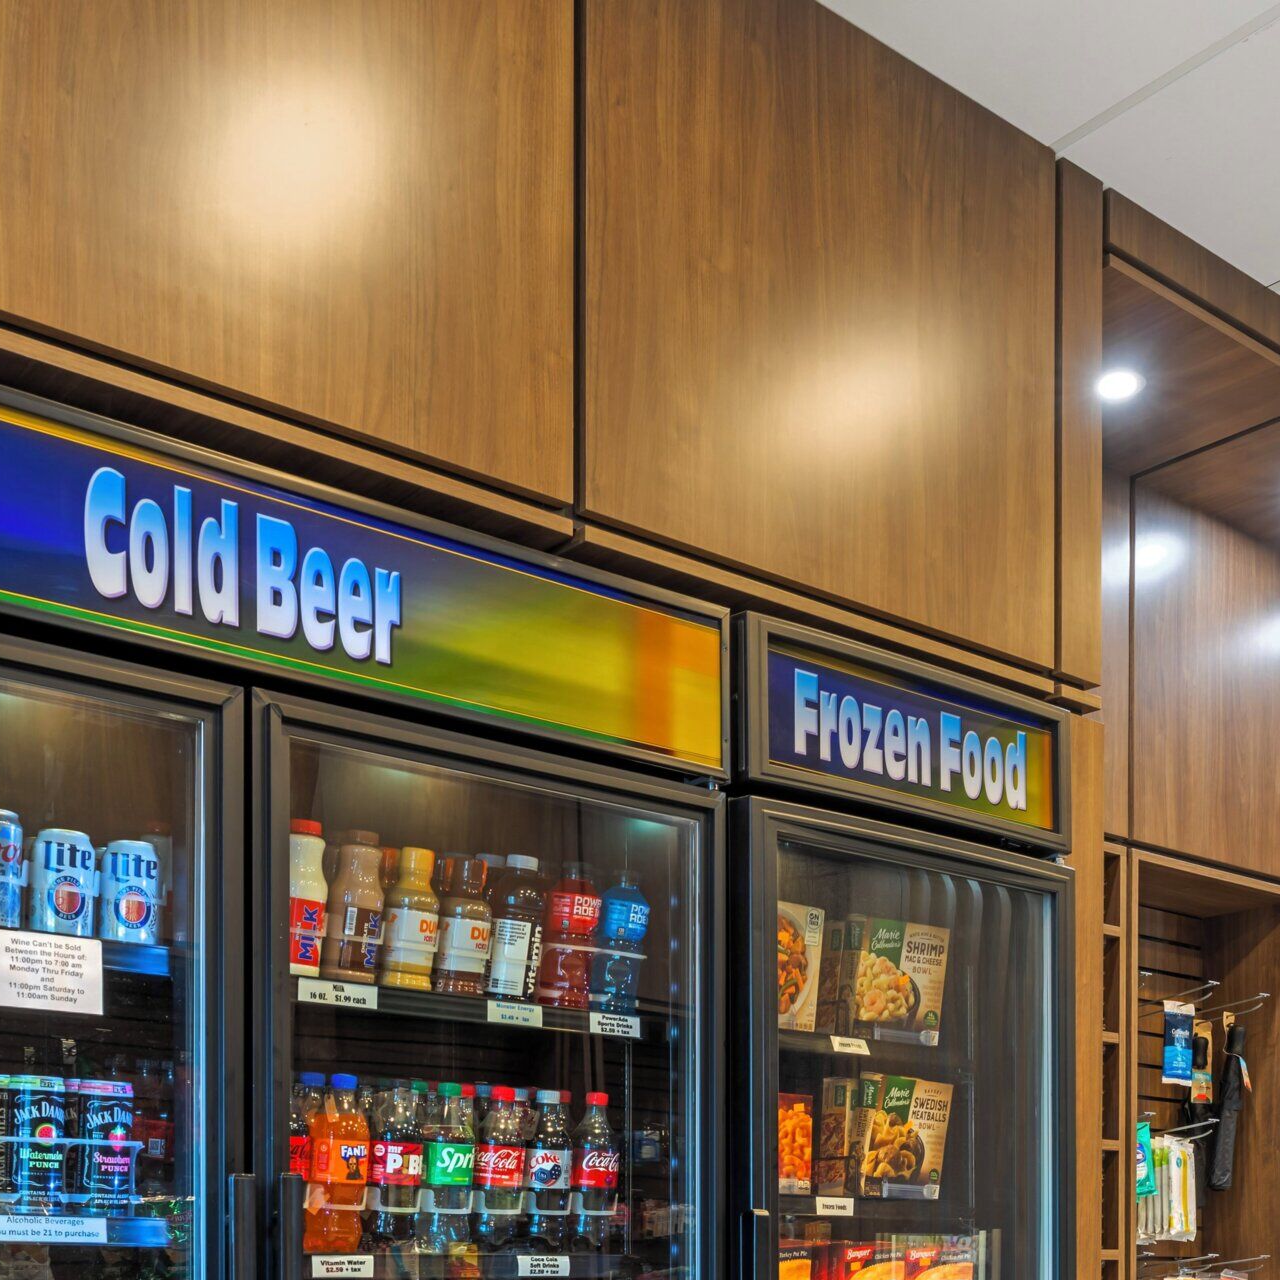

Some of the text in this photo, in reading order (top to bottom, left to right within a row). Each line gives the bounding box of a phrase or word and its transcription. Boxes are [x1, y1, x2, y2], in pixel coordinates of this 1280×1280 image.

[84, 466, 401, 664] Cold Beer
[794, 668, 1027, 811] Frozen Food
[44, 840, 91, 873] Lite
[111, 852, 158, 883] Lite
[876, 928, 901, 940] Marie
[10, 938, 30, 946] Wine
[32, 940, 52, 949] Can't
[64, 943, 81, 951] Sold
[906, 941, 945, 957] SHRIMP
[5, 946, 87, 961] Between the Hours of:
[527, 926, 543, 994] vitamin
[10, 956, 43, 965] 11:00pm
[54, 959, 69, 967] 7:00
[904, 955, 943, 967] MAC CHEESE
[9, 964, 83, 979] Monday Thru Friday
[912, 966, 933, 975] BOWL
[9, 982, 41, 991] 11:00pm
[43, 985, 75, 995] Saturday
[332, 984, 345, 993] Milk
[16, 991, 78, 1004] 11:00am Sunday
[352, 995, 367, 1005] each
[616, 1022, 633, 1030] Drinks
[886, 1087, 910, 1099] Marie
[914, 1097, 949, 1112] SWEDISH
[14, 1105, 39, 1124] JACK
[86, 1110, 111, 1129] JACK
[912, 1110, 947, 1123] MEATBALLS
[387, 1145, 403, 1153] mr
[6, 1215, 85, 1227] Alcoholic Beverages
[9, 1228, 28, 1237] must
[30, 1228, 41, 1236] be
[43, 1228, 53, 1236] 21
[55, 1229, 63, 1237] to
[65, 1229, 100, 1239] purchase
[347, 1259, 366, 1267] Water
